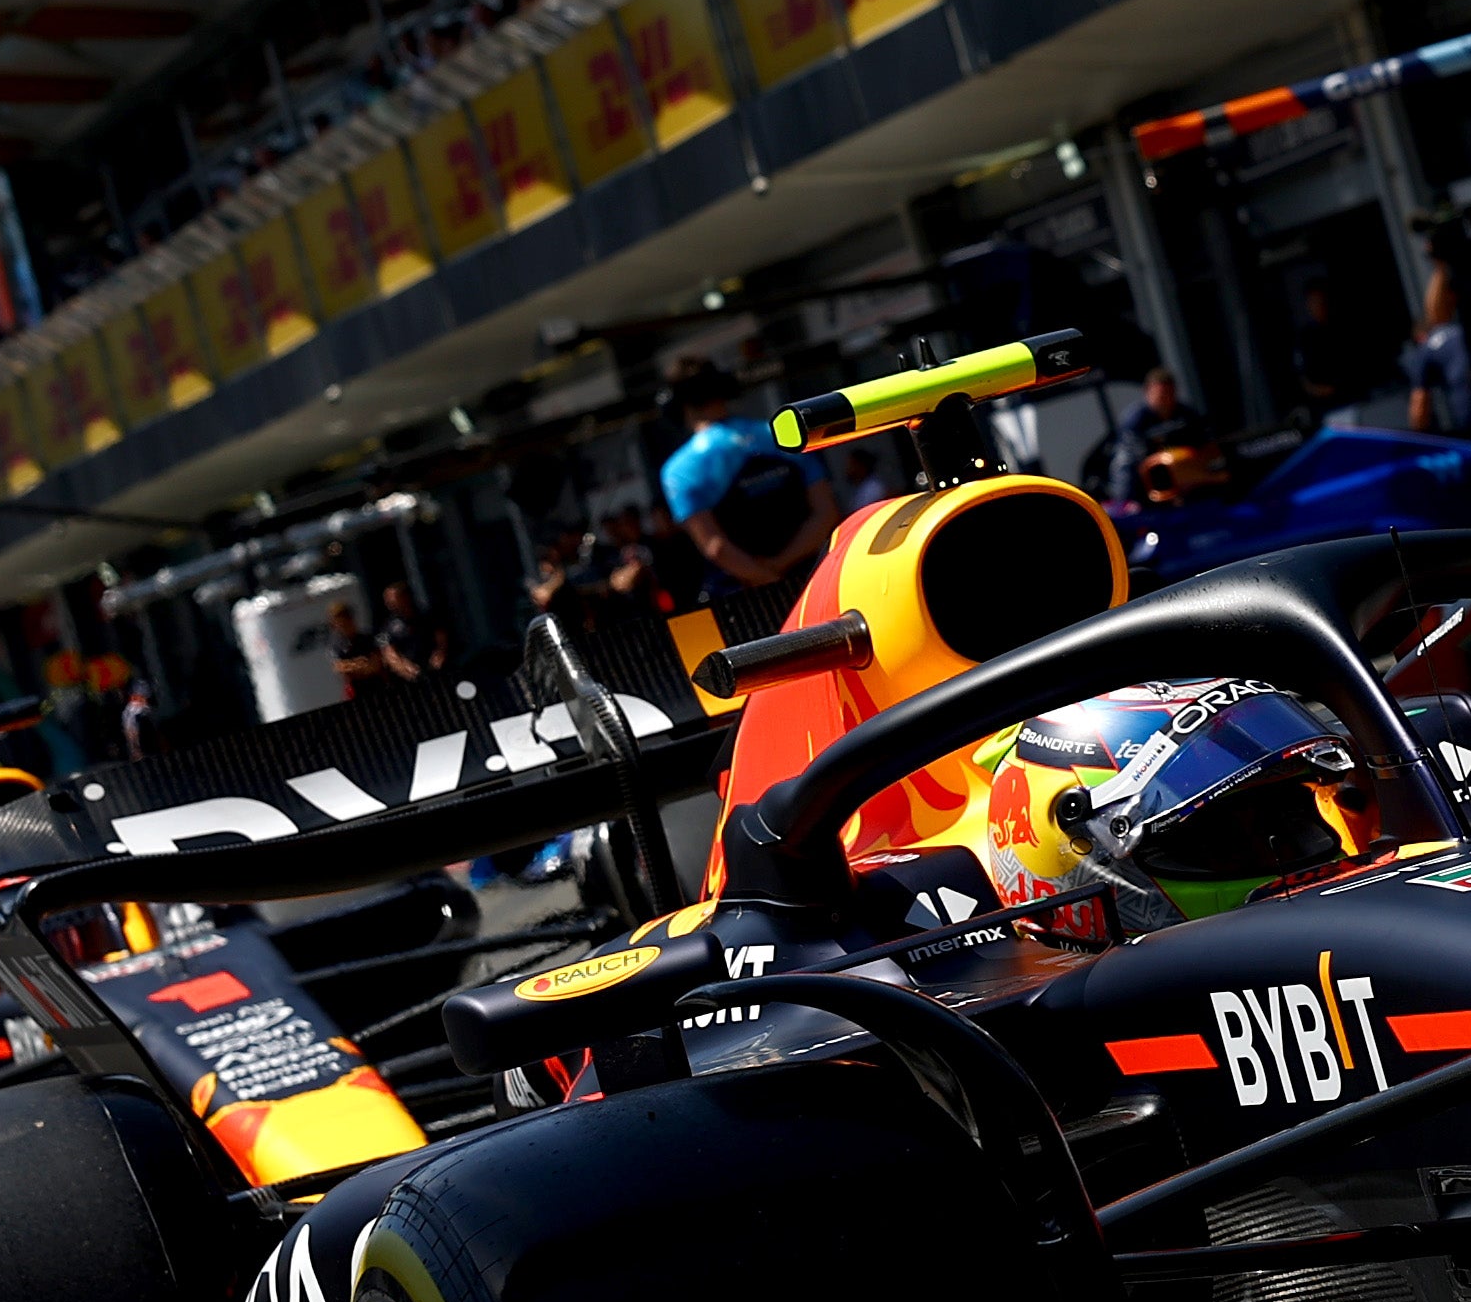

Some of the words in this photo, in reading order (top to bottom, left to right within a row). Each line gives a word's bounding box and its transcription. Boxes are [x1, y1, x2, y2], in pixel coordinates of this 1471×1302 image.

[1028, 730, 1097, 755] BANORTE
[908, 925, 1008, 965] inter.mx
[553, 948, 641, 988] RAUCH
[1210, 950, 1388, 1107] BYBIT
